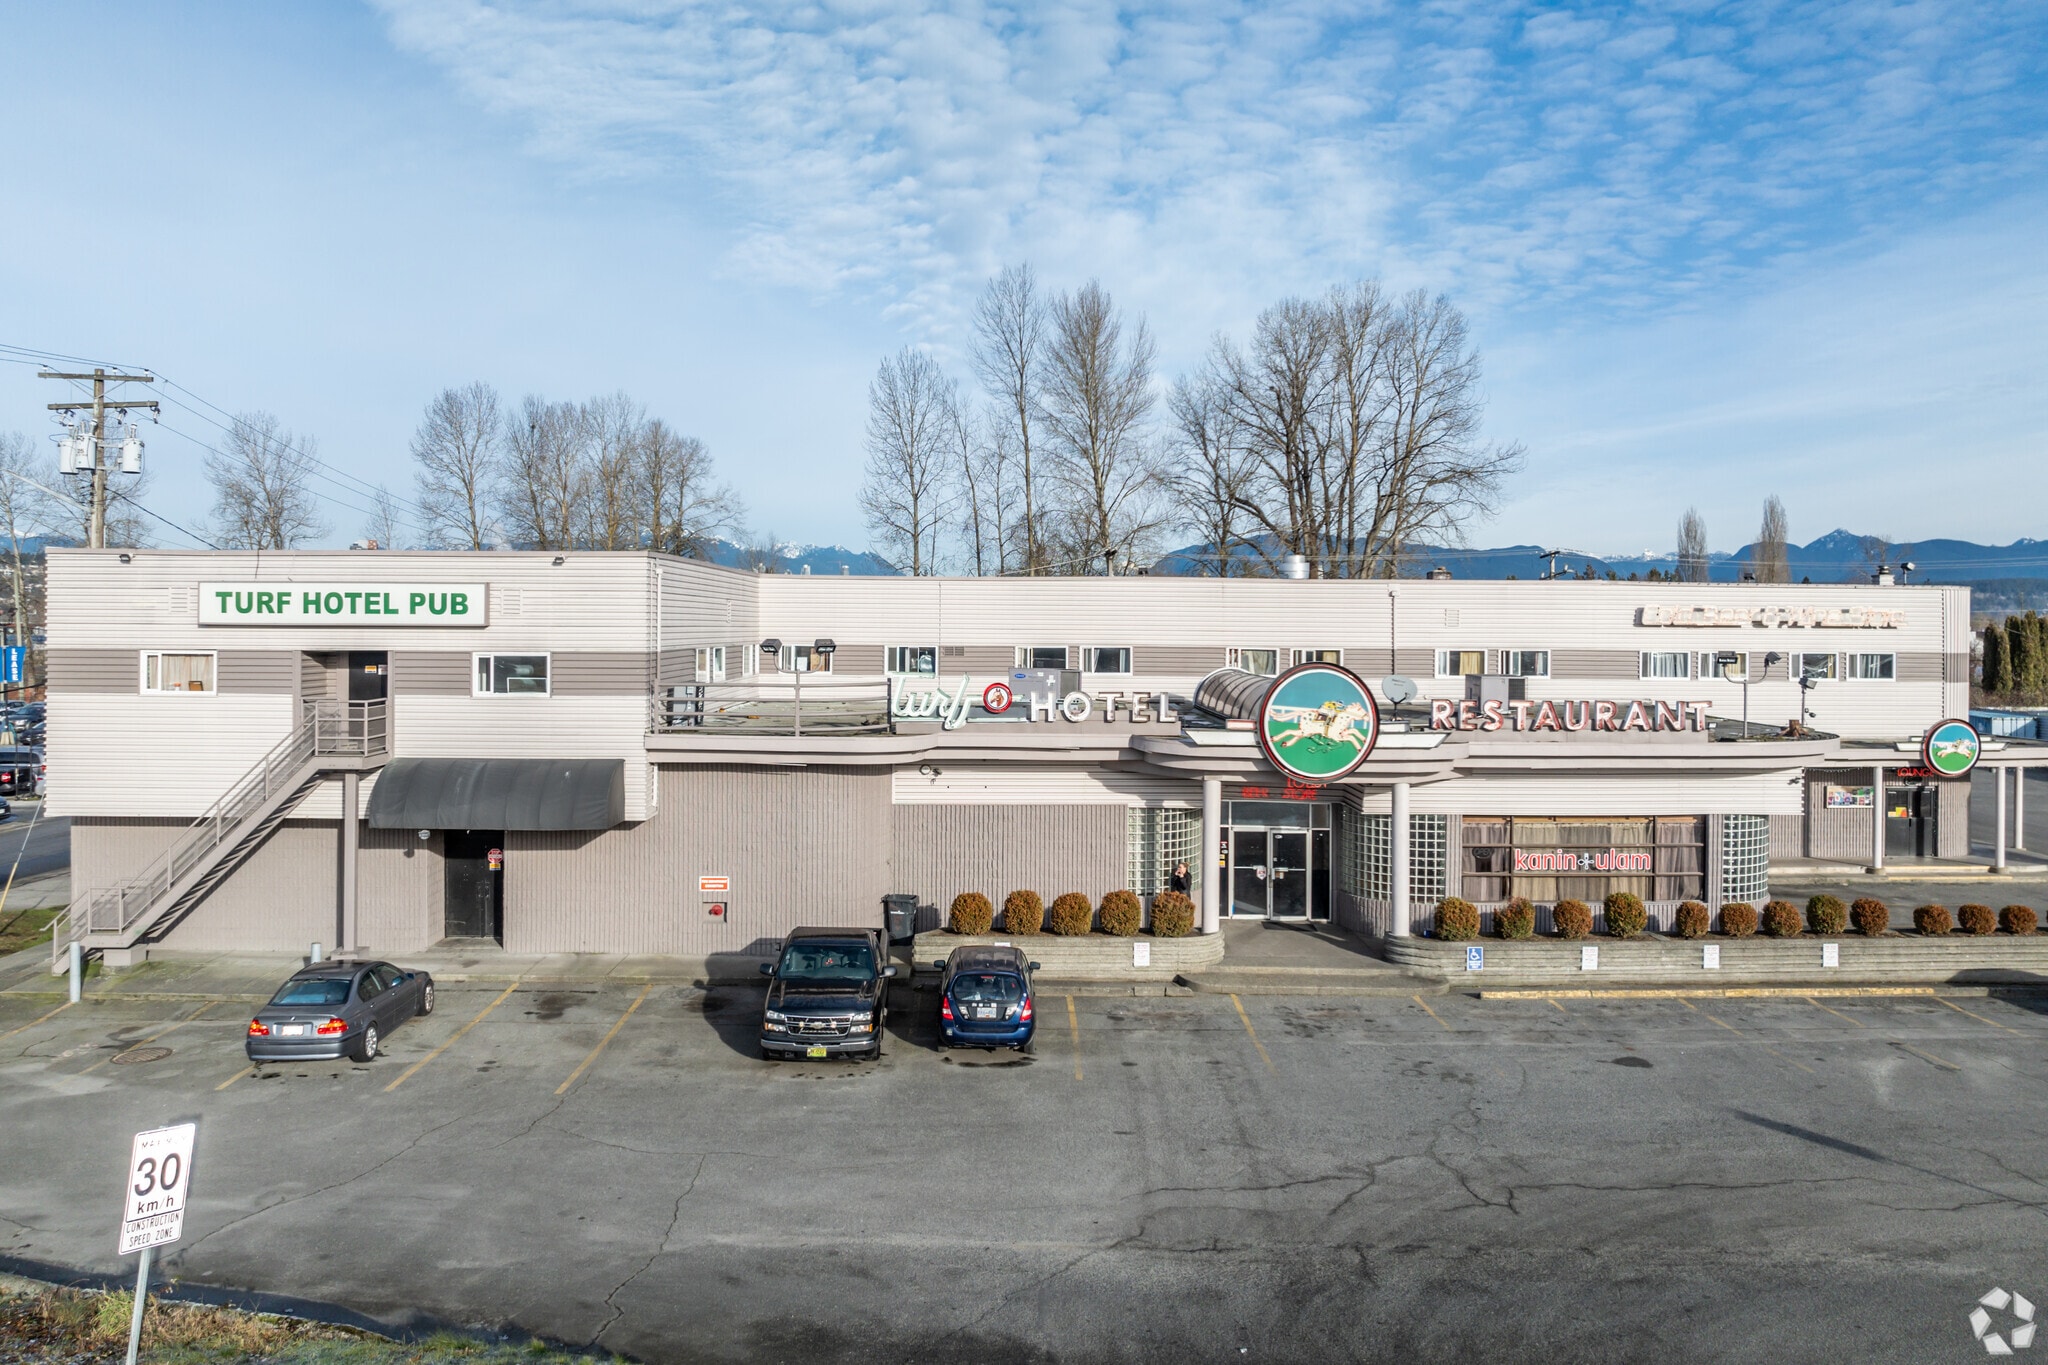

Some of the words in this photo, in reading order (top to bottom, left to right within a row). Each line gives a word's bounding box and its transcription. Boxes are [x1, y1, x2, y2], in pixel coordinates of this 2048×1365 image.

[215, 591, 292, 614] TURF
[302, 591, 399, 614] HOTEL
[409, 592, 469, 615] PUB
[1030, 690, 1178, 723] HOTEL
[1430, 699, 1713, 732] RESTAURANT
[134, 1152, 181, 1196] 30
[137, 1194, 175, 1215] km/h
[126, 1212, 180, 1234] CONSTRUCTION
[129, 1232, 152, 1248] SPEED
[155, 1226, 174, 1241] ZONE
